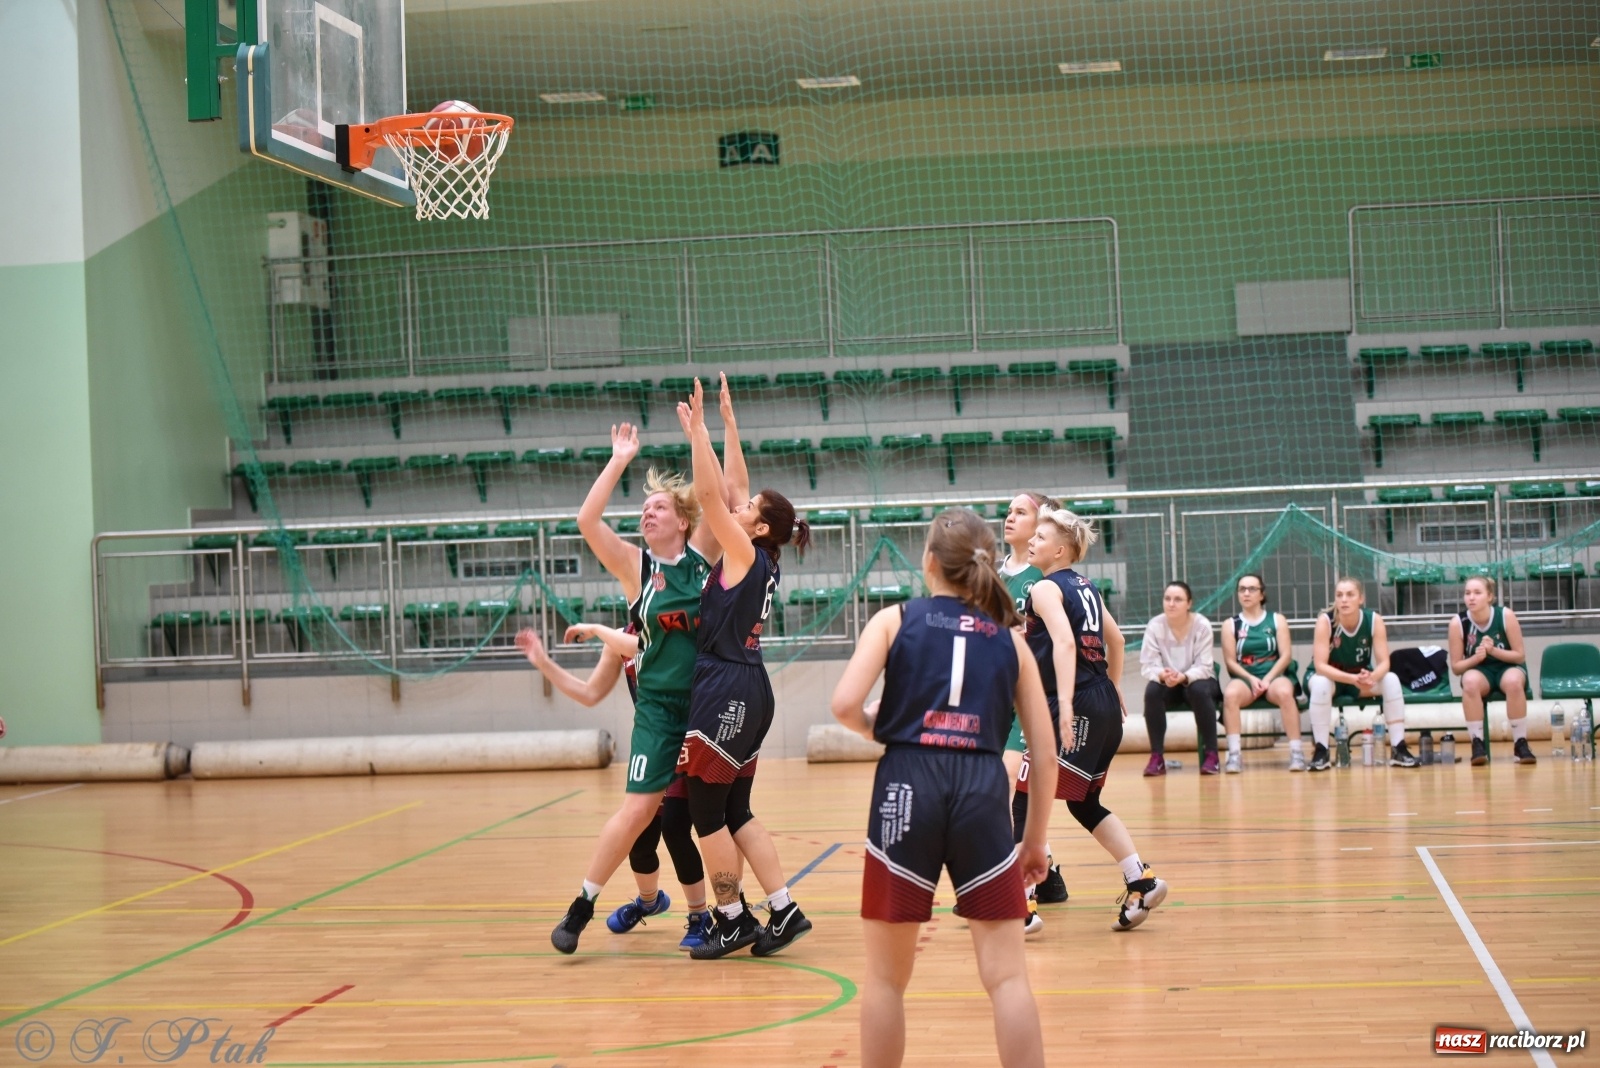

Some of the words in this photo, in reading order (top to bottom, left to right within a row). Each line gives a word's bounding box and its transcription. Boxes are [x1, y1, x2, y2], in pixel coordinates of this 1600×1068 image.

[750, 144, 773, 161] A
[948, 635, 966, 707] 1
[629, 753, 648, 782] 10
